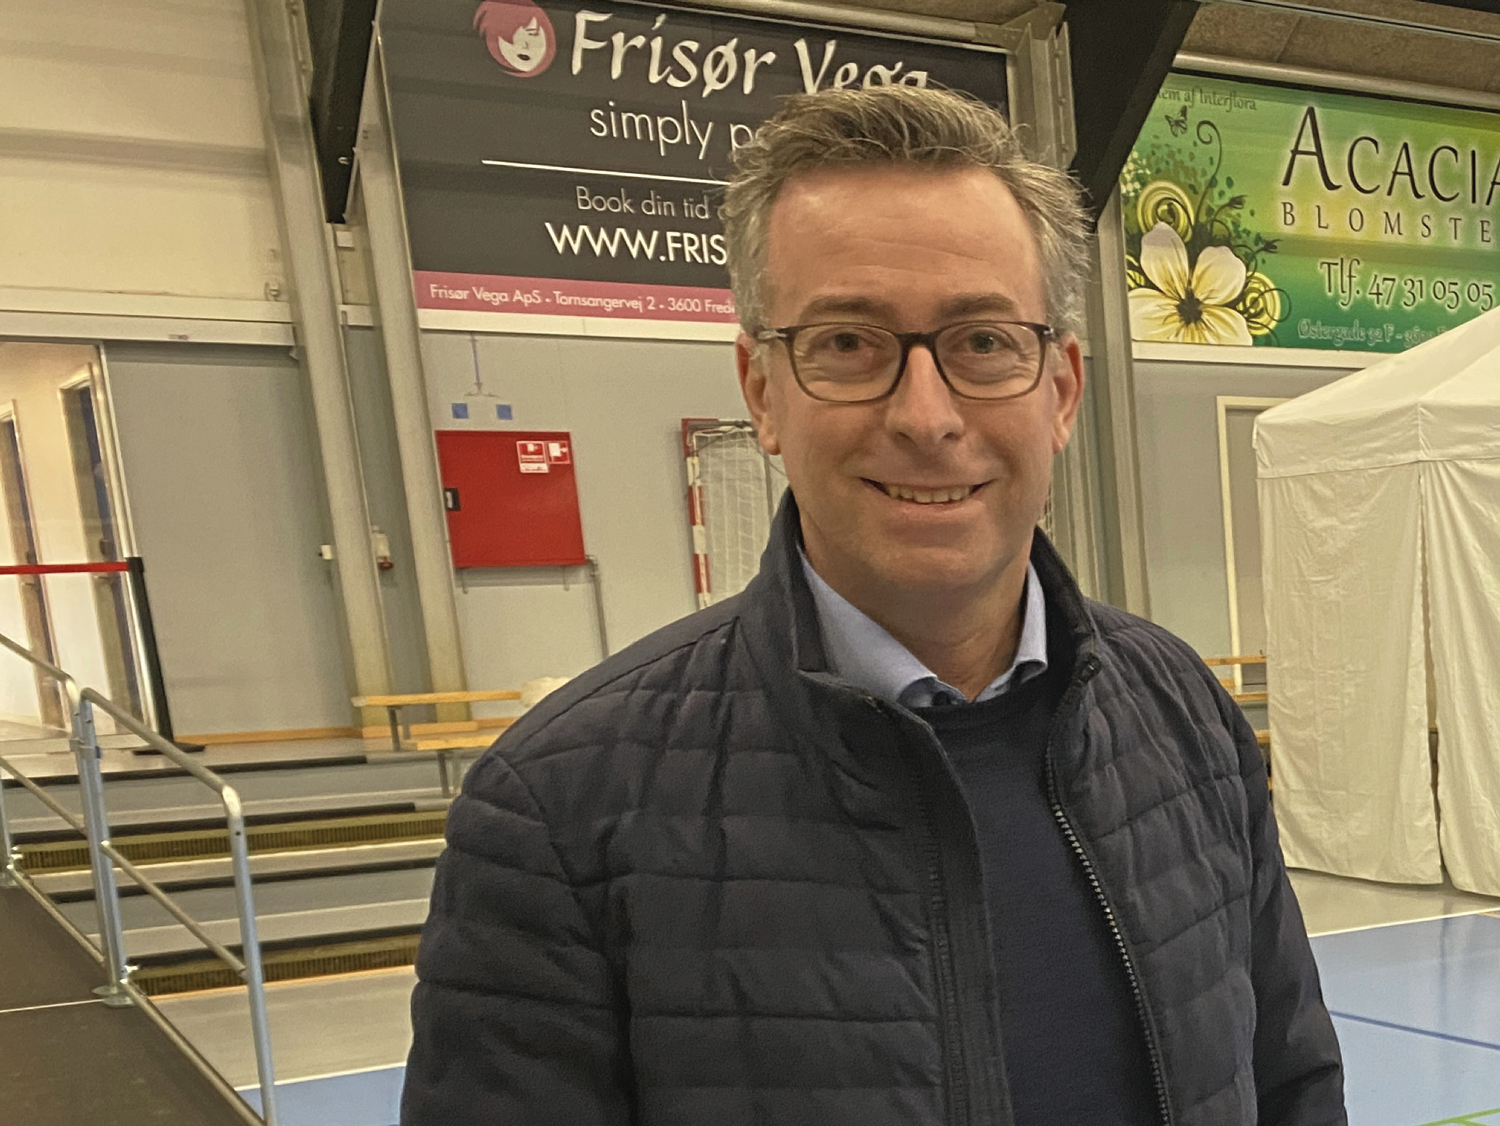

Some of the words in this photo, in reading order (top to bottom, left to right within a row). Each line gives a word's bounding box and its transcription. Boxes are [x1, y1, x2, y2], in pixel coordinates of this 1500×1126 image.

[1200, 88, 1257, 113] Interflora
[590, 100, 714, 159] simply
[576, 186, 635, 213] Book
[641, 190, 675, 217] din
[683, 195, 709, 219] tid
[430, 284, 469, 299] Frisør
[472, 286, 508, 306] Vega
[513, 290, 541, 307] ApS
[647, 296, 656, 310] 2
[668, 297, 701, 312] 3600
[1320, 257, 1361, 307] Tlf.
[1368, 274, 1396, 306] 47
[1403, 278, 1424, 307] 31
[1432, 280, 1459, 310] 05
[1467, 282, 1493, 311] 05
